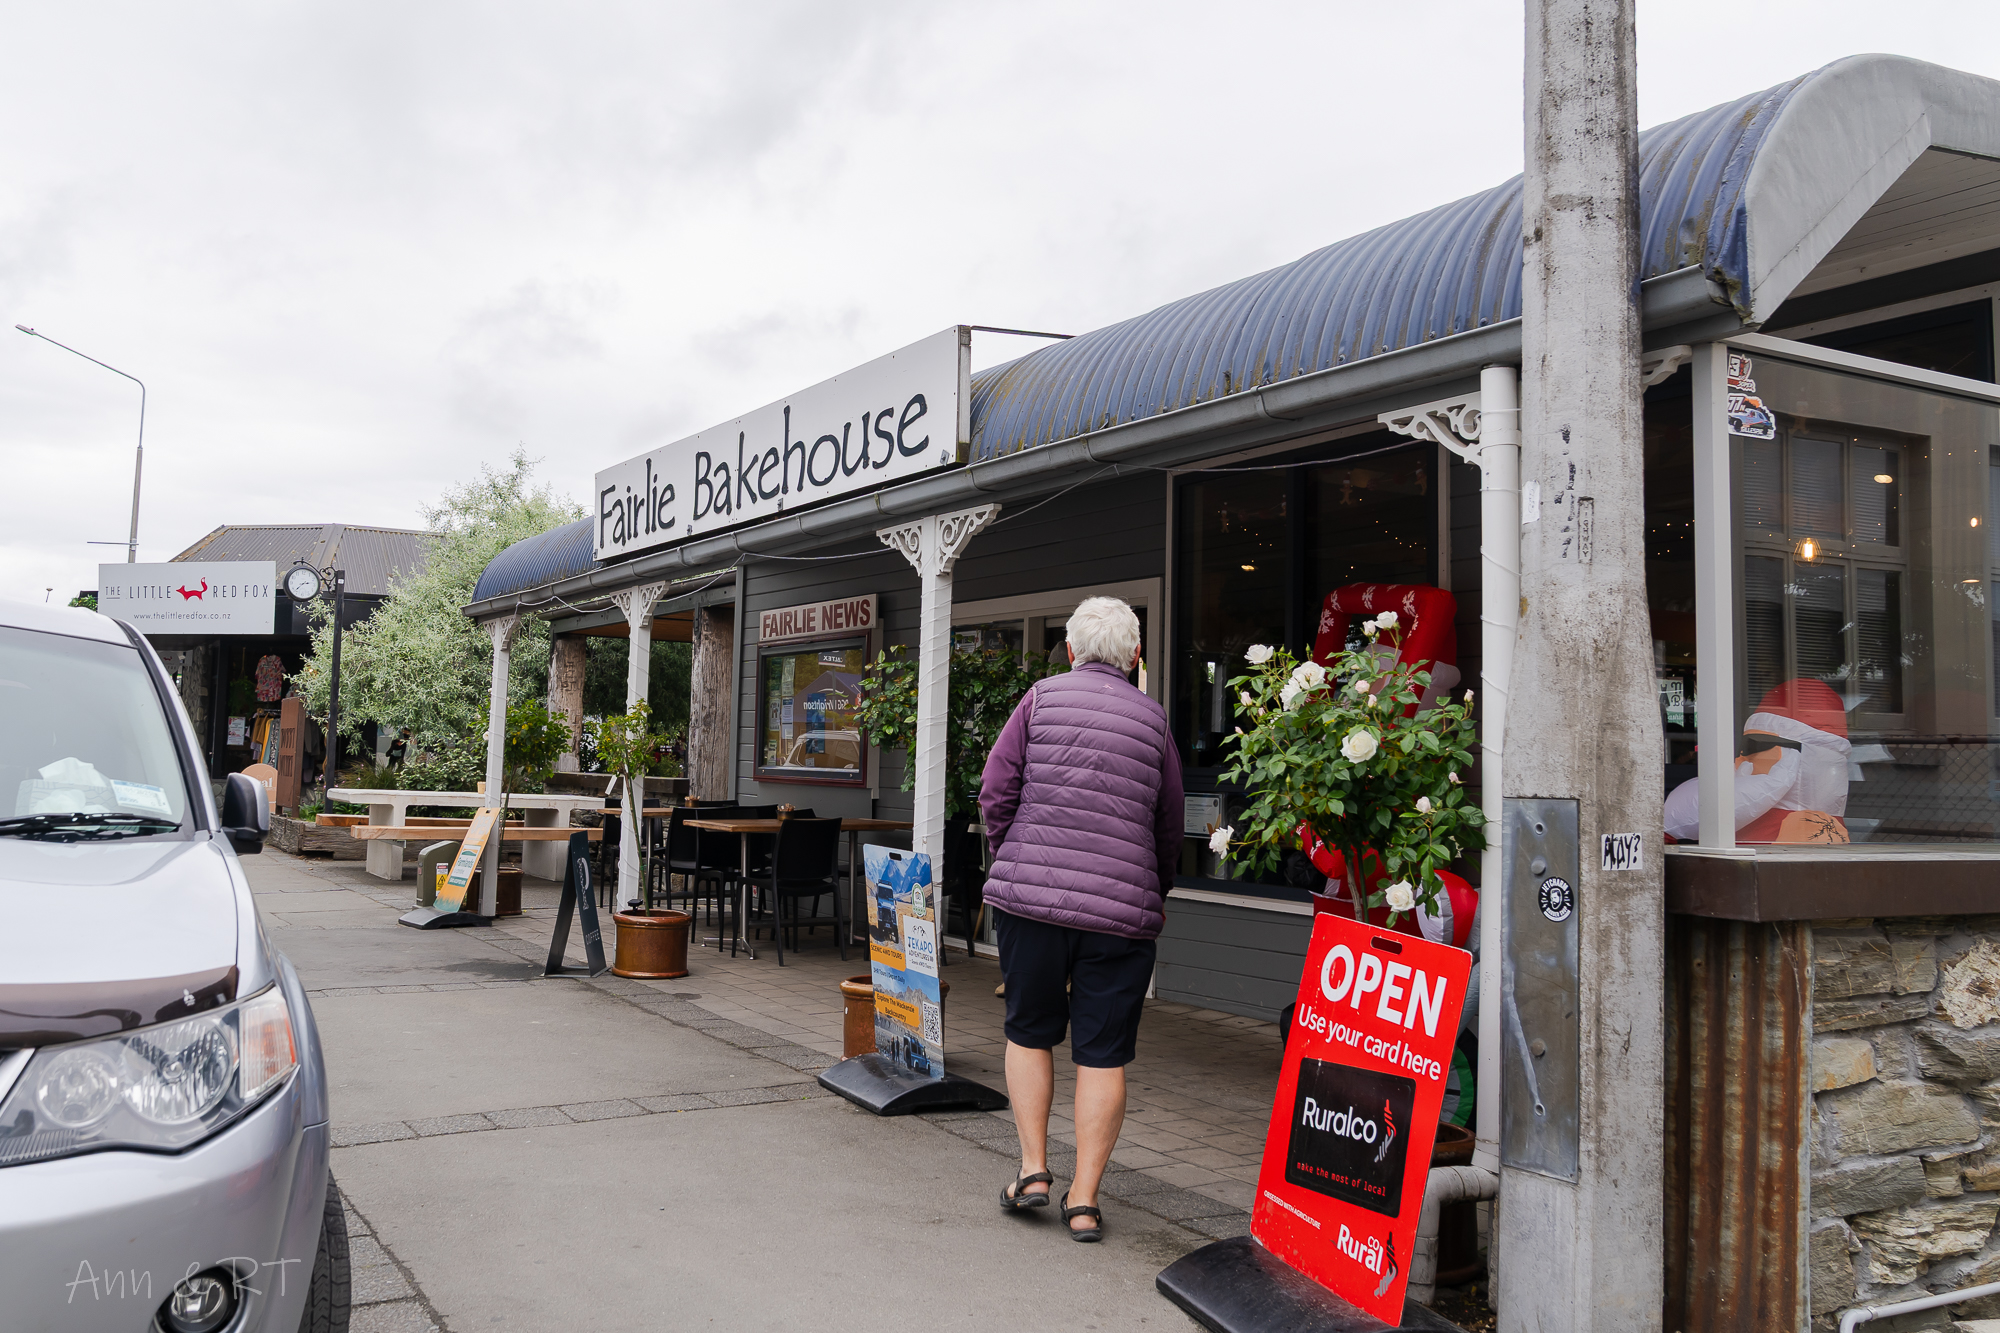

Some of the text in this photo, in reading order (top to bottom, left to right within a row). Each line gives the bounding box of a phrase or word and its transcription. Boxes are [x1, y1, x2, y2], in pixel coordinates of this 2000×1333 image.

[600, 394, 930, 549] Fairlie Bakehouse
[105, 585, 268, 599] THE LITTLE RED FOX
[133, 611, 231, 620] www.thelittleredfox.co.nz
[762, 599, 870, 638] FAIRLIE NEWS
[585, 929, 600, 945] COFFEE
[890, 950, 903, 960] TOURS
[907, 936, 933, 954] TEKAPO
[1320, 944, 1448, 1038] OPEN
[1298, 1003, 1442, 1081] Use your card here
[1302, 1096, 1378, 1144] Ruralco
[1296, 1161, 1386, 1197] make the most of local
[1263, 1190, 1321, 1230] OBSESSED WITH AGRICULTURE
[1336, 1223, 1384, 1275] Rural
